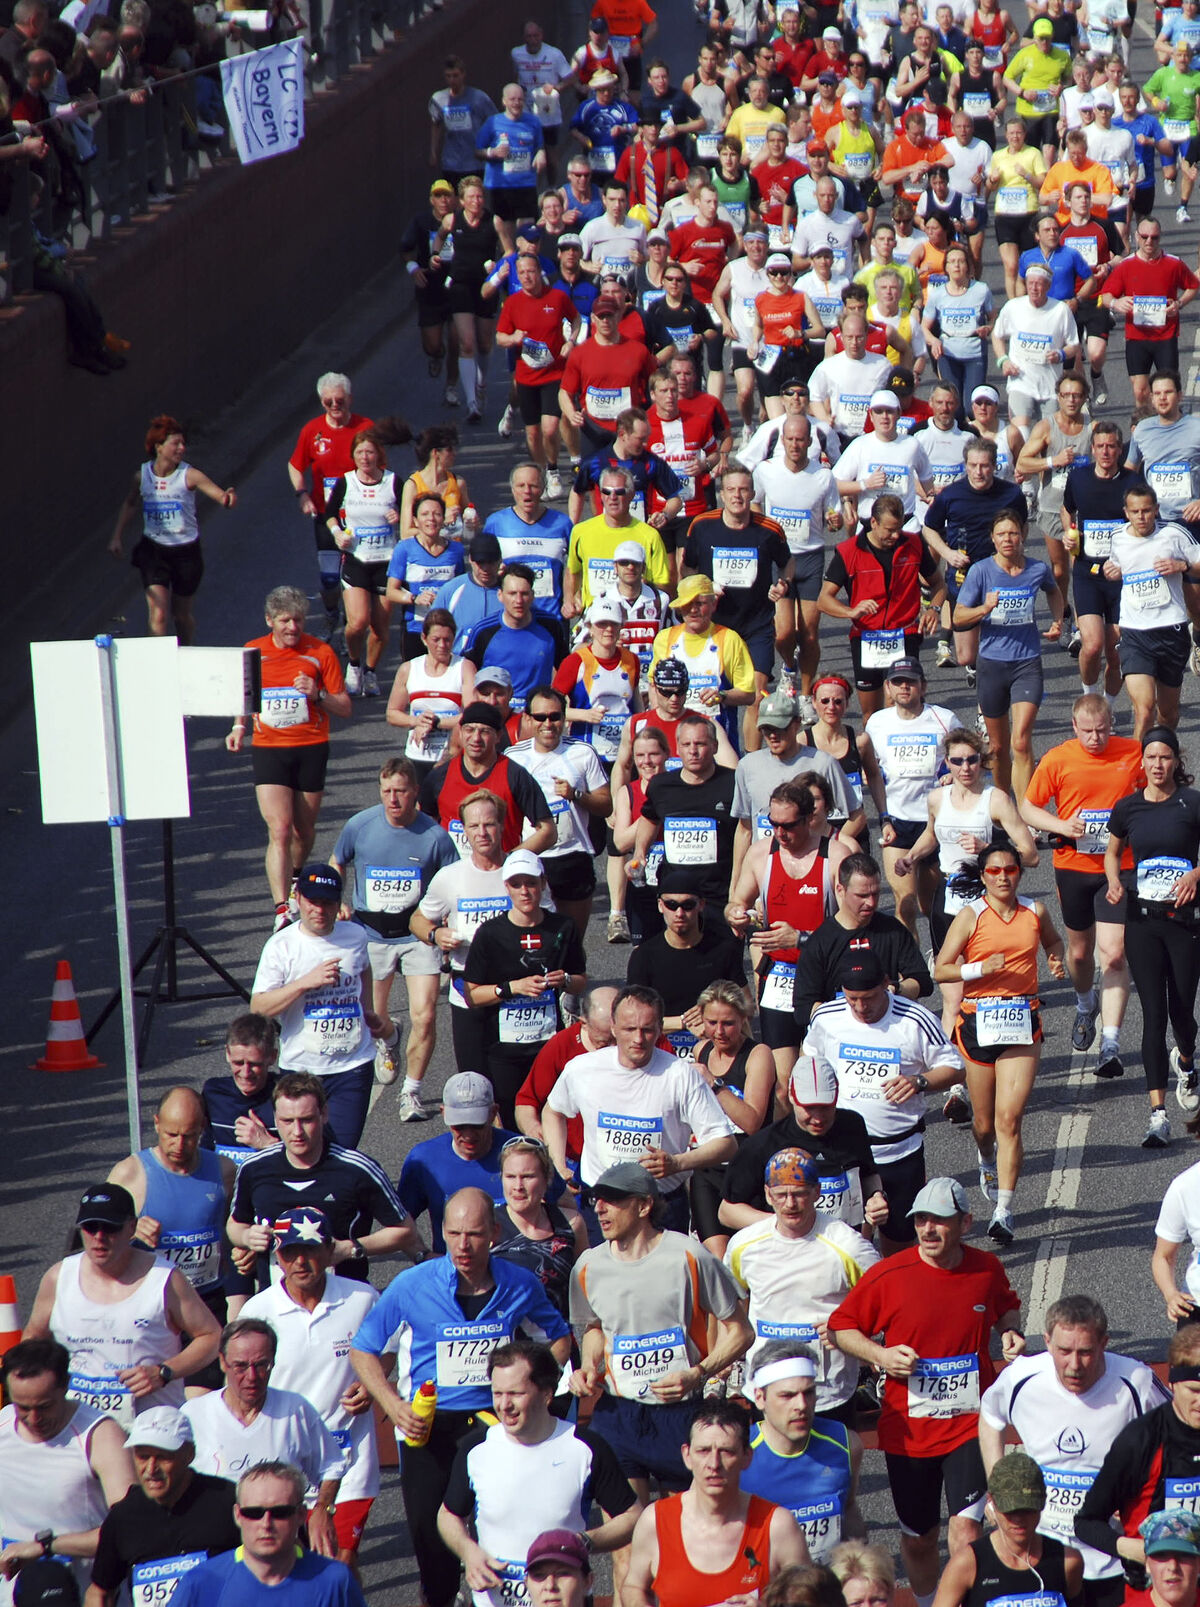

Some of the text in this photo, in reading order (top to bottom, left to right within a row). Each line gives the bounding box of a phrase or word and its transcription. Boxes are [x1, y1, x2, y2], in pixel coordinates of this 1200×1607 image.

[252, 68, 279, 145] Bayern
[1156, 473, 1183, 482] 8755
[717, 549, 753, 557] CONERGY
[719, 559, 751, 569] 11857
[1131, 580, 1160, 594] 13548
[996, 599, 1028, 609] F6957
[266, 699, 299, 710] 1315
[891, 736, 932, 744] CONERGY
[893, 746, 928, 757] 18245
[1079, 811, 1110, 819] CONER
[668, 820, 711, 828] CONERGY
[671, 830, 708, 843] 19246
[1143, 859, 1189, 867] CONERGY
[371, 869, 415, 877] CONERGY
[372, 880, 412, 892] 8548
[462, 900, 507, 908] CONERGY
[773, 976, 794, 989] 125
[505, 1007, 547, 1021] F4971
[983, 1008, 1023, 1023] F4465
[313, 1018, 353, 1033] 19143
[514, 1019, 543, 1027] Cristina
[322, 1032, 346, 1040] Stefan
[1001, 1033, 1019, 1042] asics
[844, 1047, 894, 1059] CONERGY
[844, 1061, 889, 1077] 7356
[602, 1116, 655, 1129] CONERGY
[605, 1129, 652, 1146] 18866
[613, 1145, 643, 1154] Hinrich
[161, 1231, 214, 1244] CONERGY
[163, 1244, 213, 1263] 17210
[443, 1323, 503, 1336] CONERGY
[761, 1324, 817, 1337] CONERGY
[447, 1338, 500, 1358] 17727
[618, 1333, 675, 1351] CONERGY
[621, 1348, 674, 1371] 6049
[633, 1364, 669, 1378] Michael
[917, 1374, 969, 1392] 17654
[931, 1391, 957, 1400] Klaus
[791, 1502, 833, 1518] NERGY
[137, 1558, 200, 1579] CONERGY
